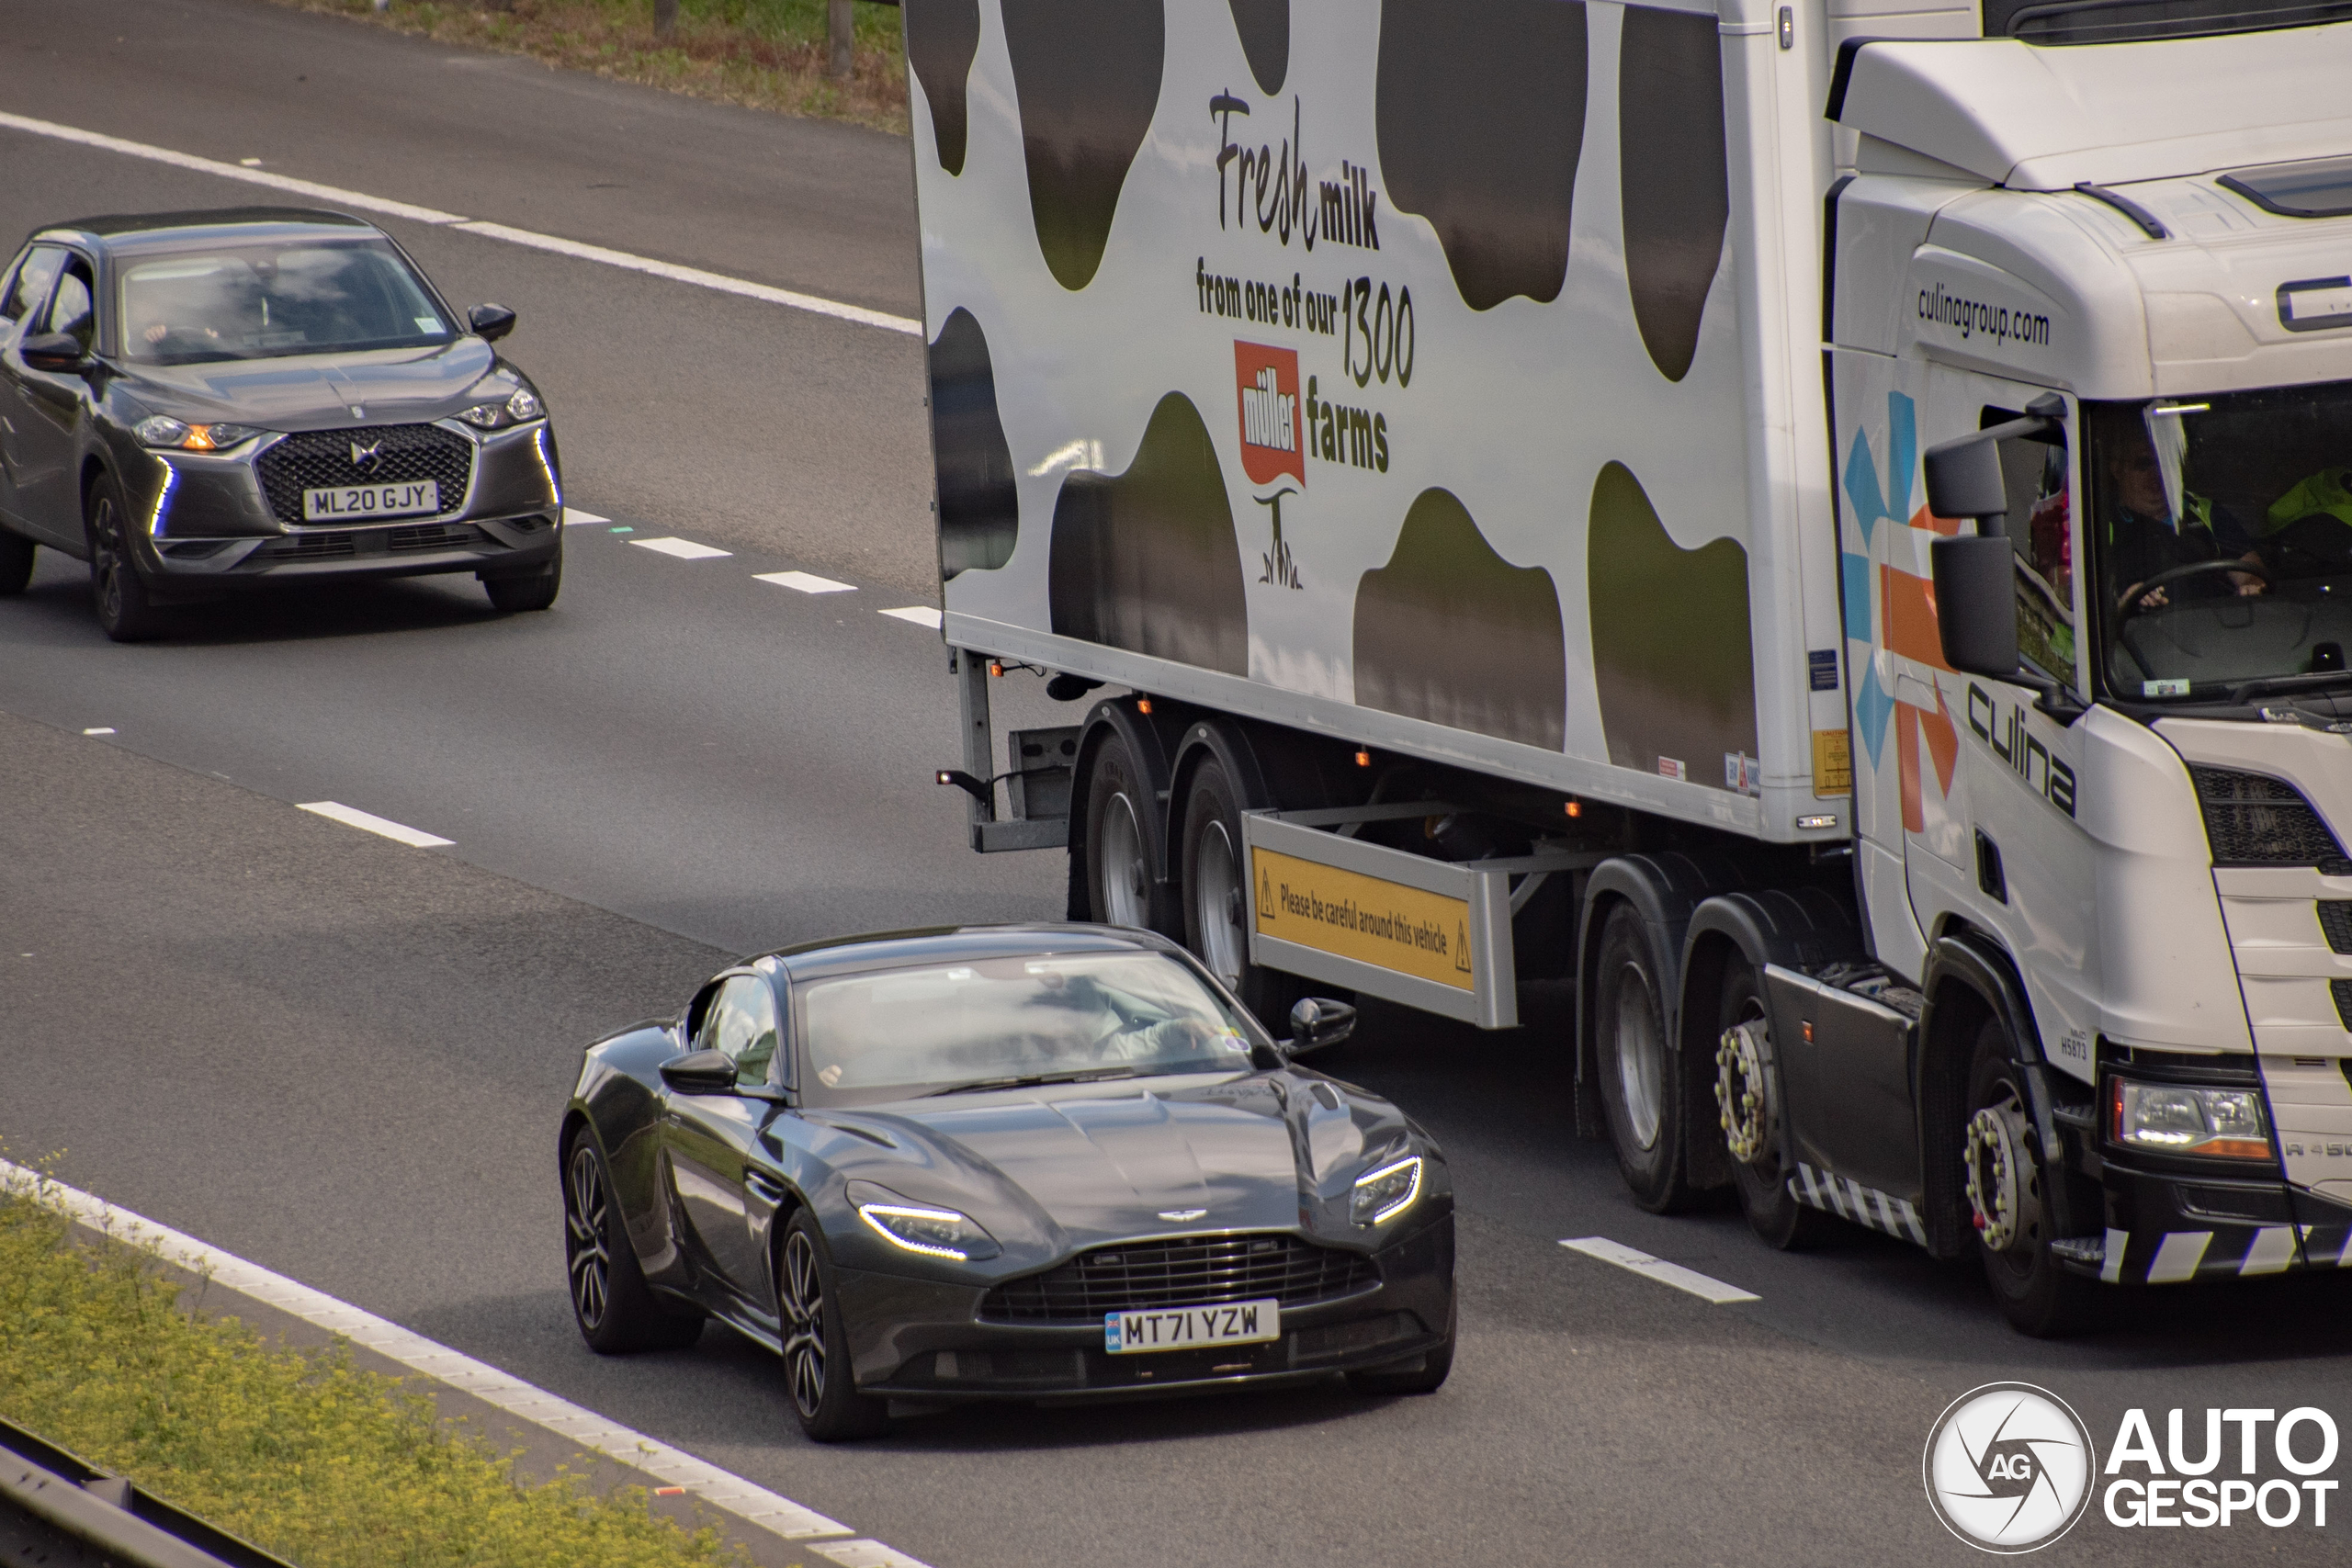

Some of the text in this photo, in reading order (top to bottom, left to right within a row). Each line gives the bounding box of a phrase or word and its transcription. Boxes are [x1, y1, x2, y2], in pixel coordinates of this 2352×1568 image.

[1209, 87, 1380, 253] Fresh milk
[1196, 256, 1414, 388] from one of our 1300
[1918, 282, 2049, 345] culinagroup.com
[1242, 366, 1295, 453] müller
[1306, 375, 1389, 473] farms
[315, 485, 425, 513] ML20 GJY
[1281, 883, 1447, 955] Please be careful around this vehicle
[2061, 1035, 2086, 1060] H5873
[2286, 1143, 2304, 1156] R
[1107, 1334, 1121, 1344] UK
[1125, 1305, 1258, 1344] MT71 YZW
